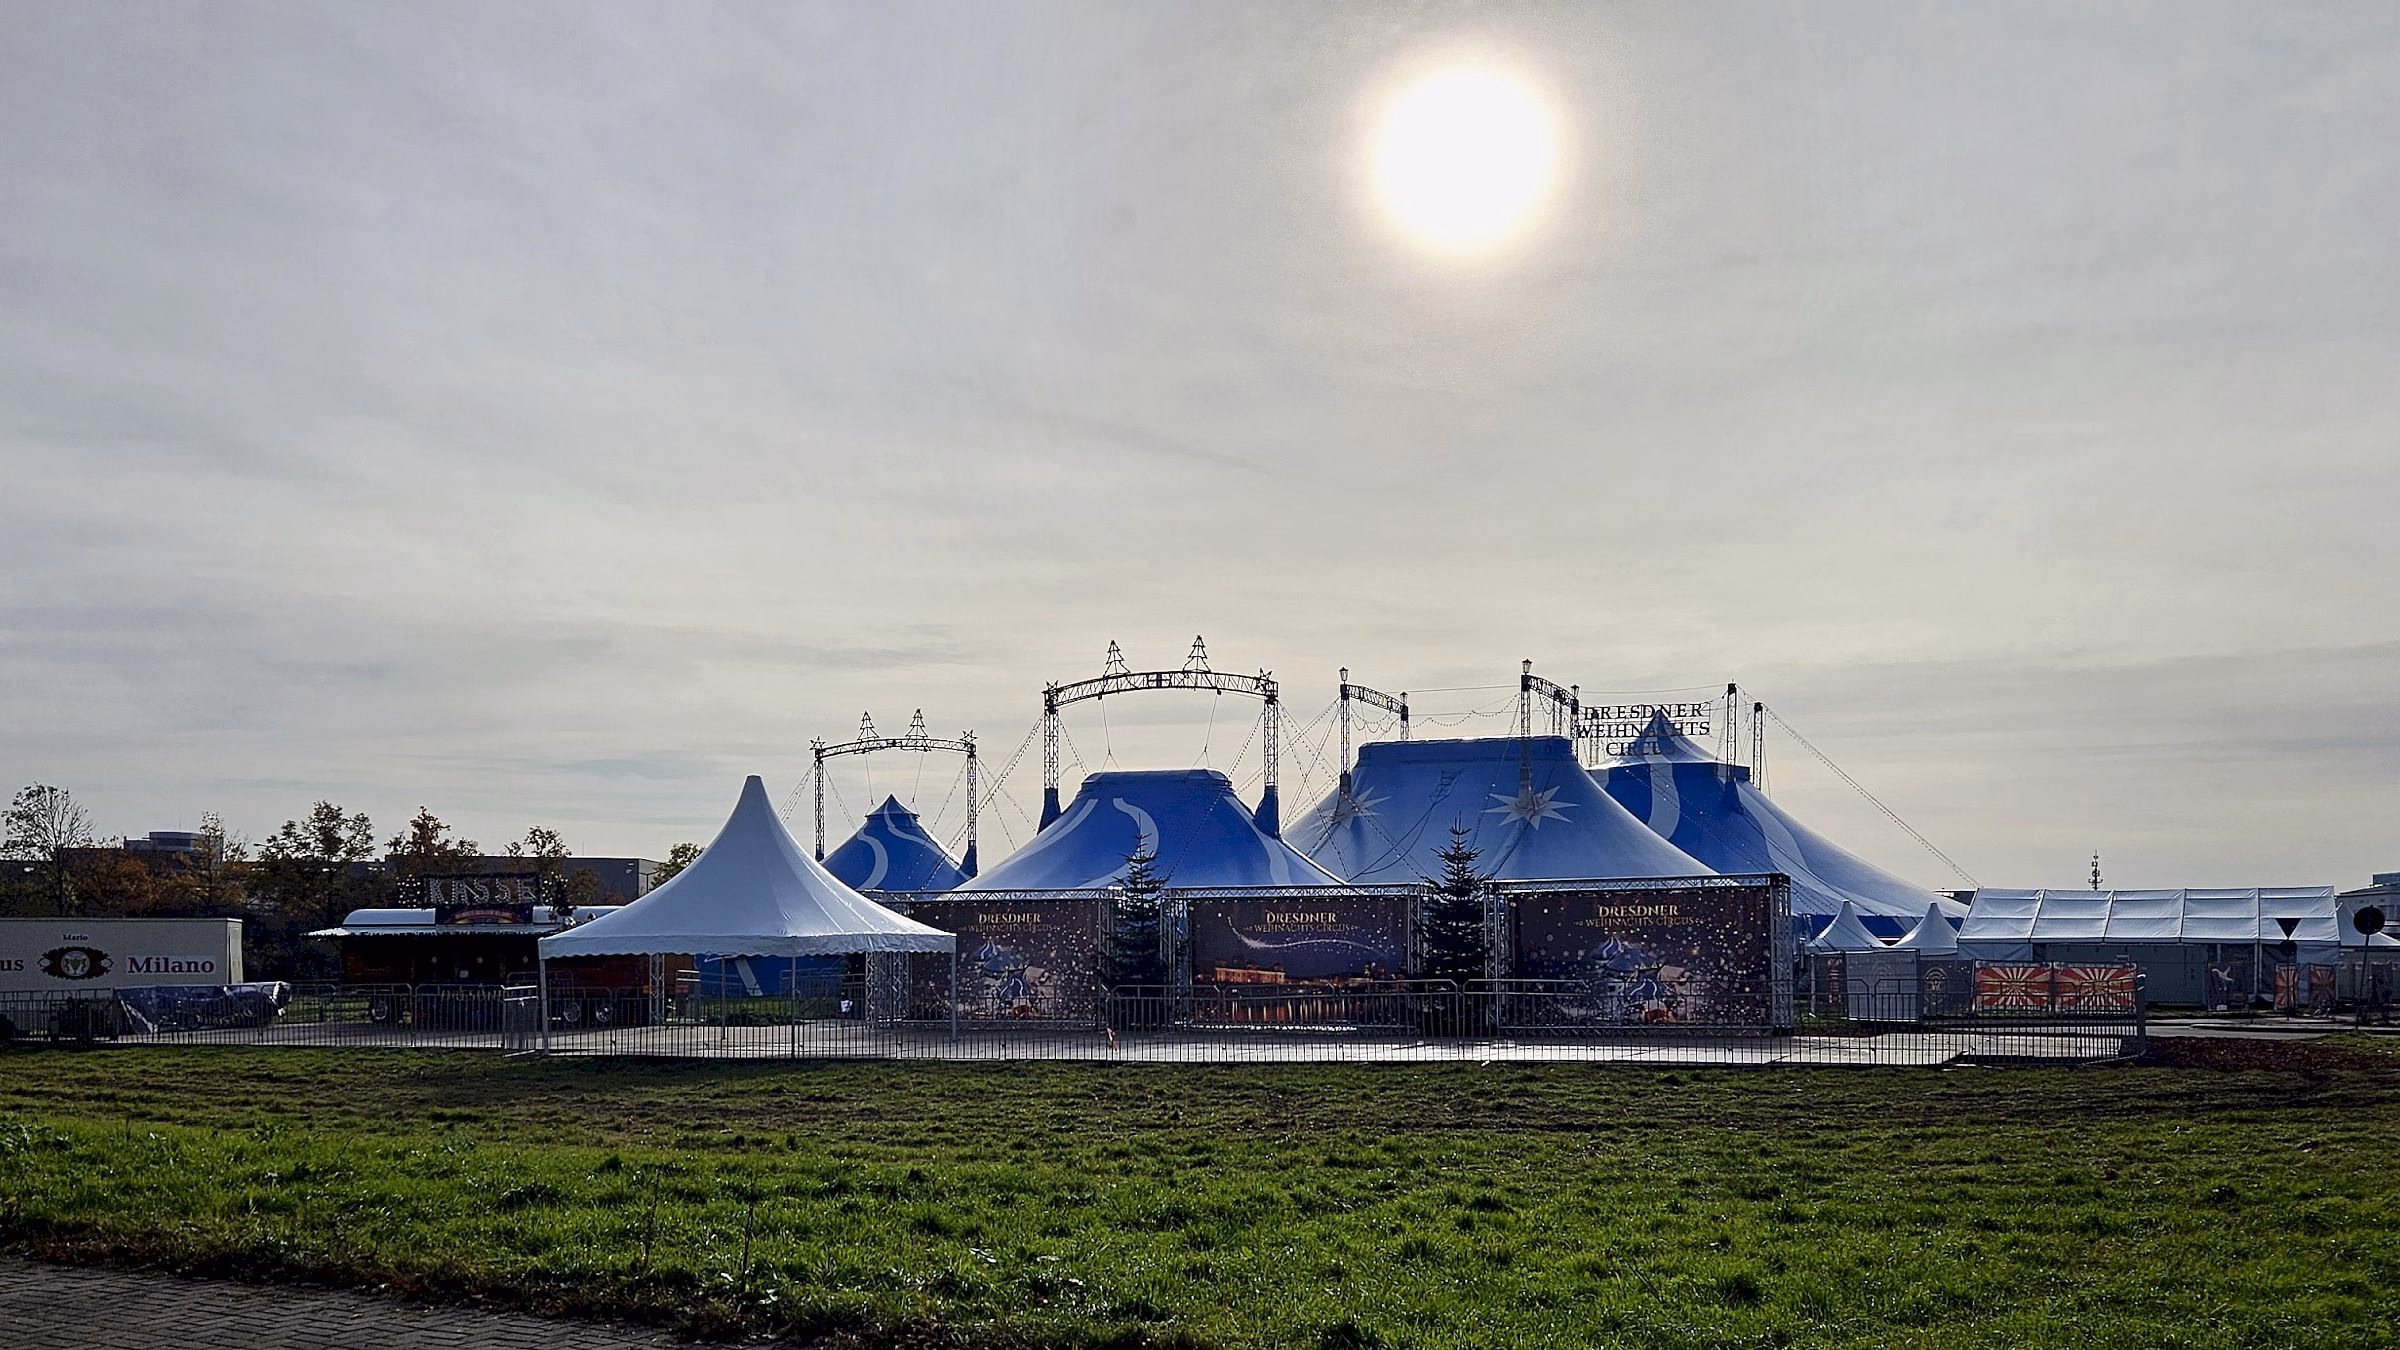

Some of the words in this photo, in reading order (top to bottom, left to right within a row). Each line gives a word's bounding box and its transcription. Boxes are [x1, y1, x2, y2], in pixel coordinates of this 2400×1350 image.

[1585, 704, 1704, 719] DRESDNER
[1606, 742, 1675, 756] CIRCU
[1266, 910, 1337, 924] DRESDNER
[1598, 904, 1679, 918] DRESDNER
[978, 912, 1041, 924] DRESDNER
[1585, 917, 1654, 928] WEIHNACHTS
[1656, 916, 1695, 928] CIRCUS
[1254, 923, 1315, 933] WEIHNACHTS
[1316, 923, 1351, 933] CIRCUS
[62, 933, 89, 941] Mario
[0, 959, 25, 972] us
[127, 956, 215, 974] Milano
